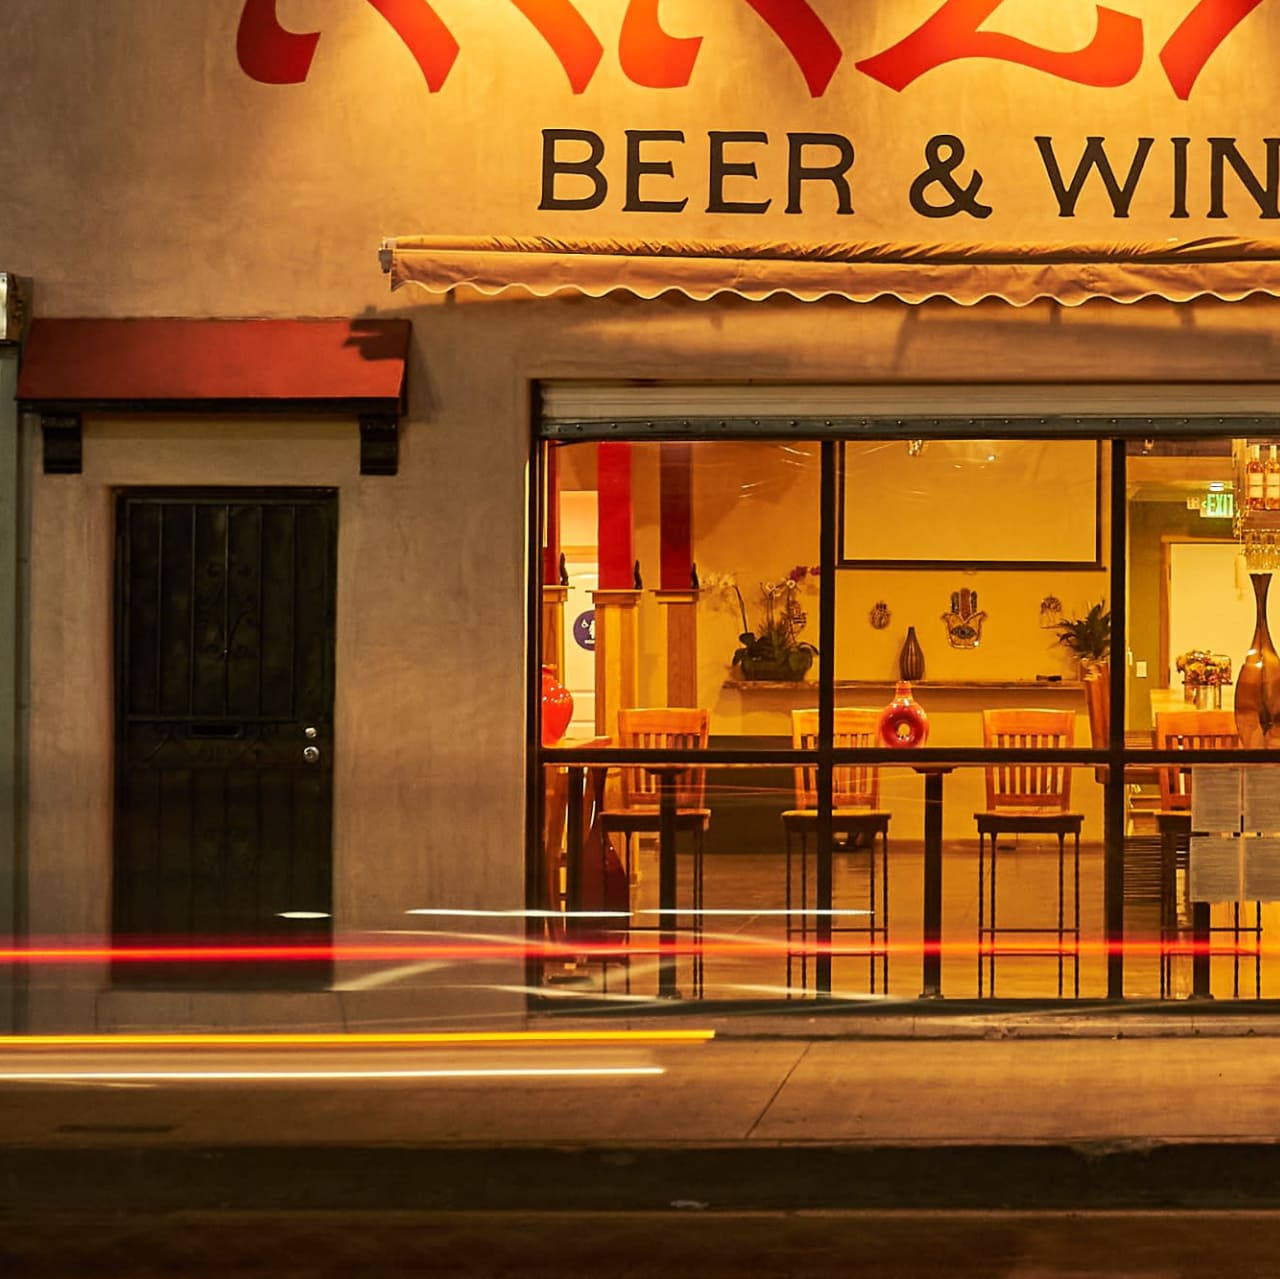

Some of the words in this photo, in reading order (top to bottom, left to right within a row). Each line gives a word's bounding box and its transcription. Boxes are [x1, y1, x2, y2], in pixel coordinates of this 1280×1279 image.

[537, 127, 858, 215] BEER
[907, 132, 994, 220] &
[1207, 494, 1233, 517] EXIT
